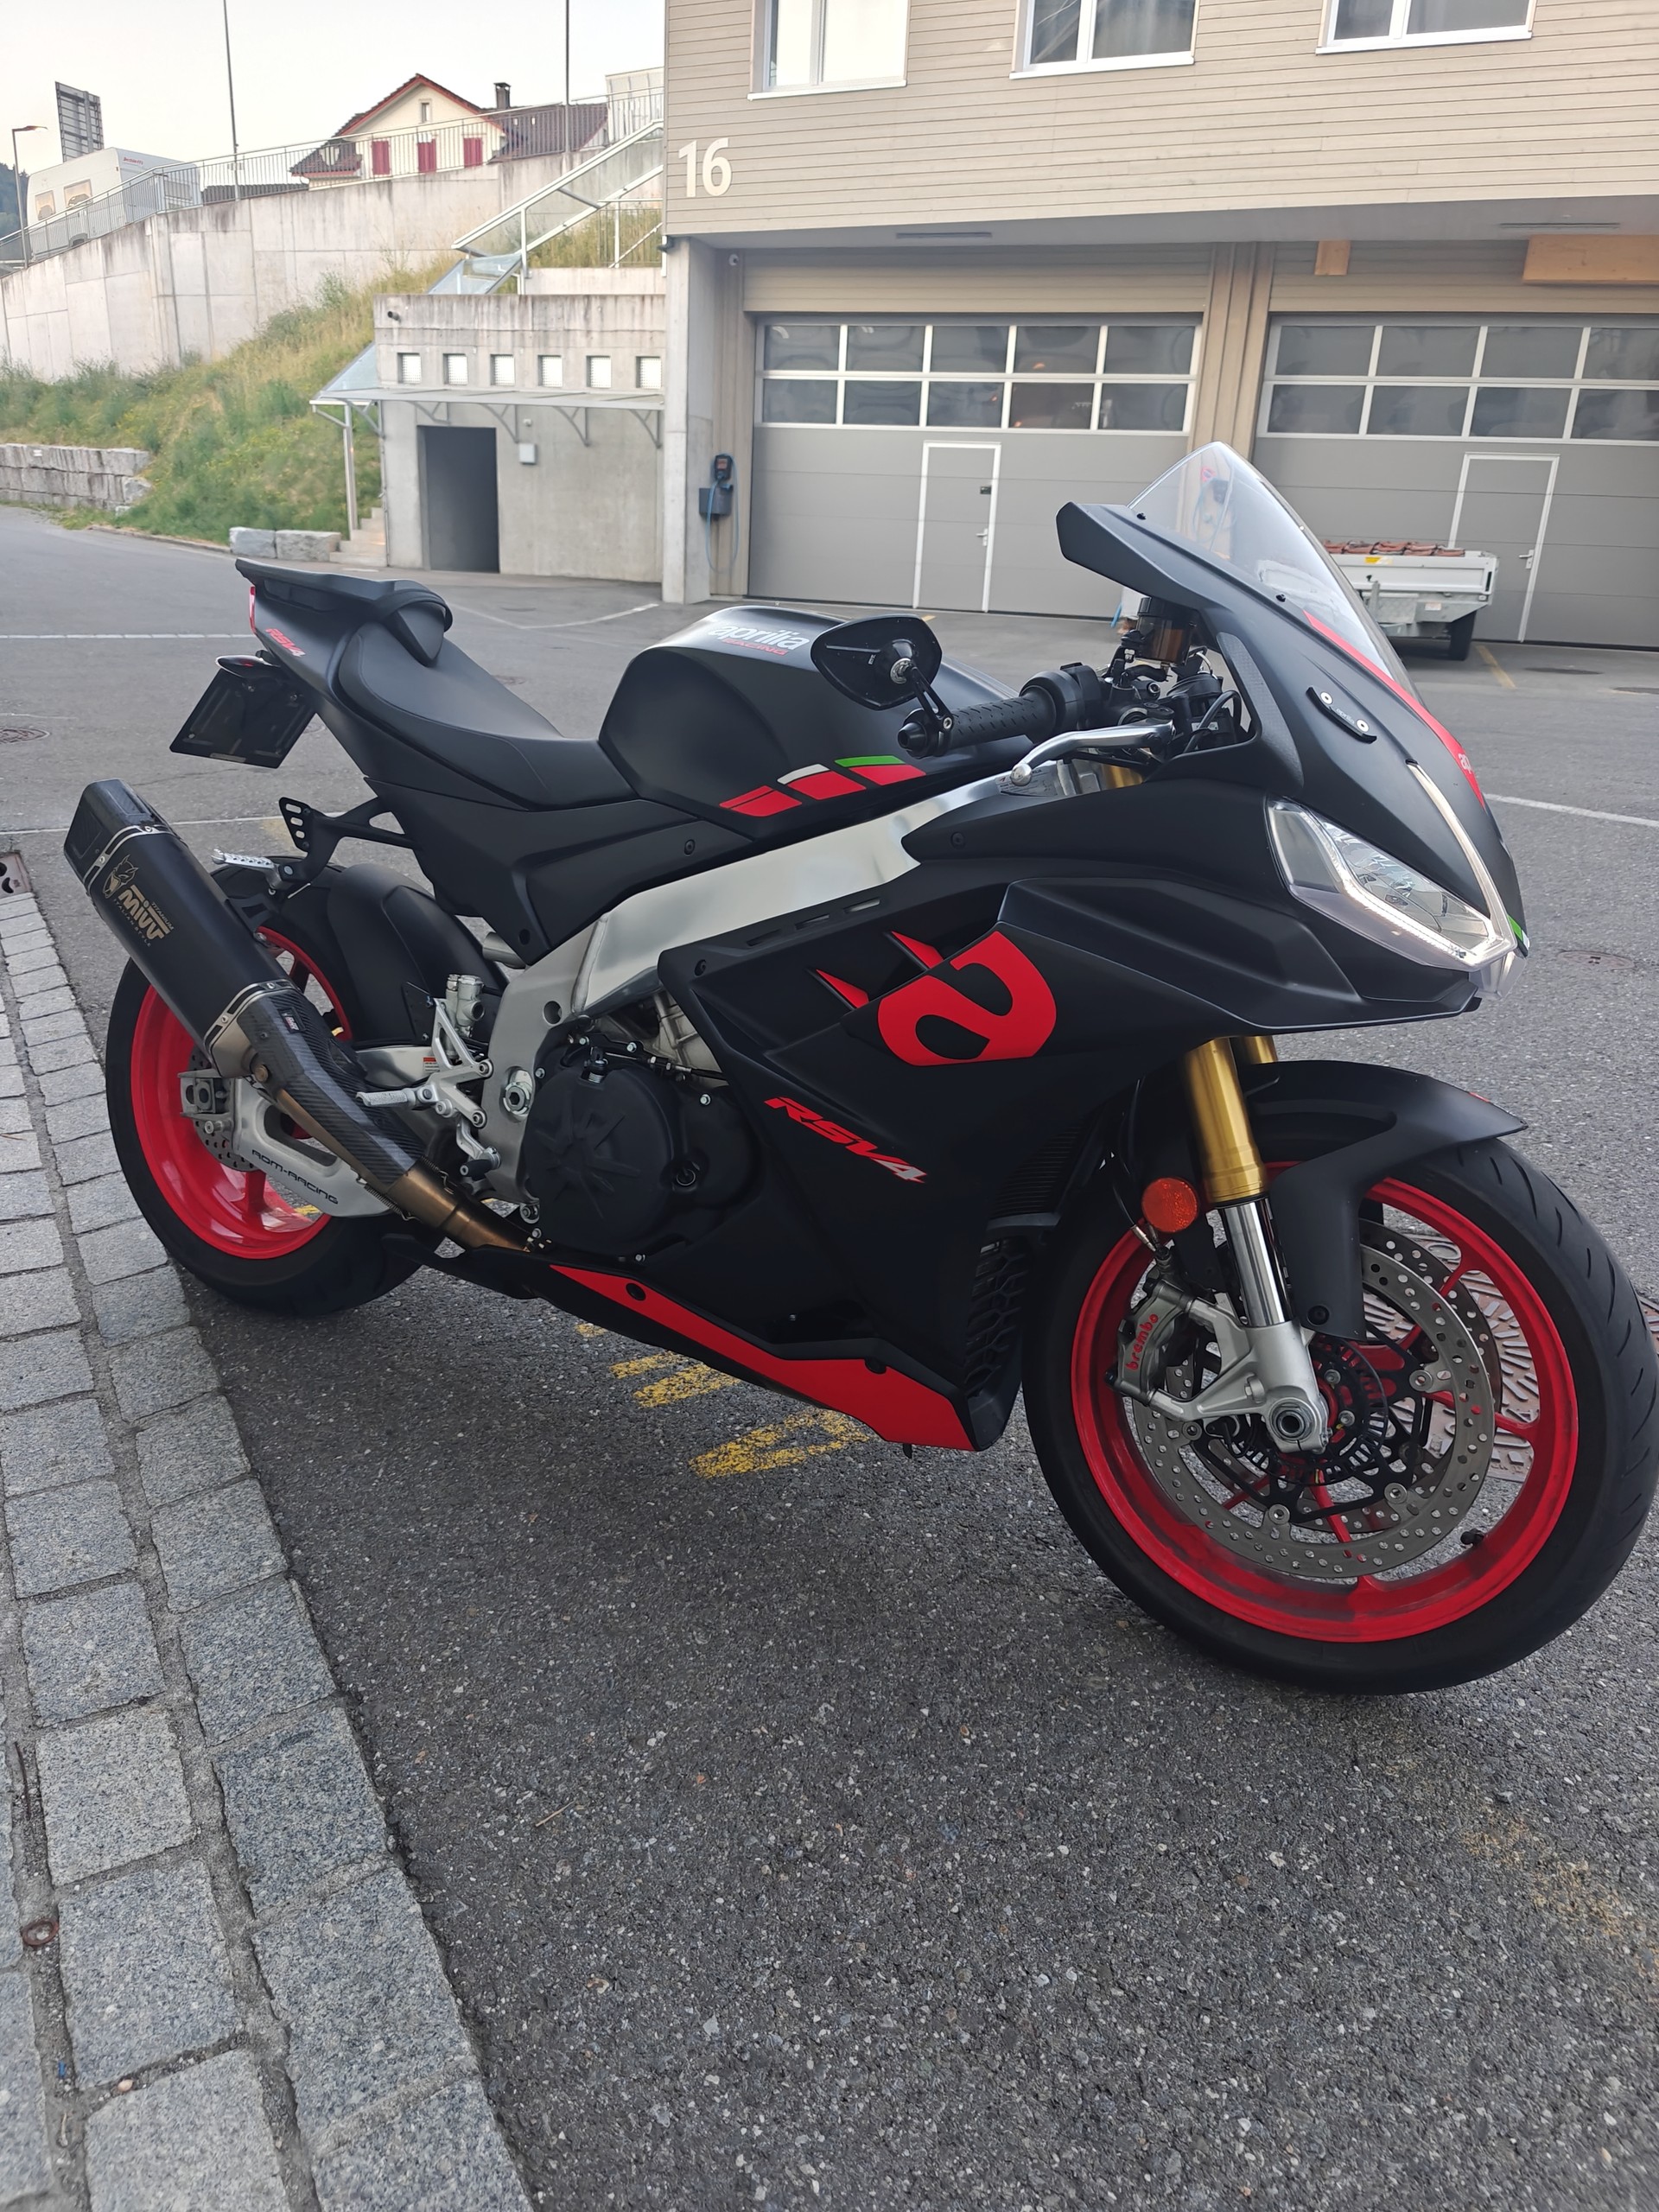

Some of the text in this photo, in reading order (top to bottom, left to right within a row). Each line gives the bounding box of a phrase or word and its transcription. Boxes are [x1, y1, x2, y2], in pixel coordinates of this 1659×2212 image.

[678, 137, 732, 197] 16
[709, 626, 810, 651] aprilia
[721, 638, 789, 656] RACING
[113, 898, 134, 925] ITALIAN
[151, 901, 175, 931] TITANIUM
[764, 1096, 927, 1184] RSV4
[1124, 1313, 1159, 1371] brembo
